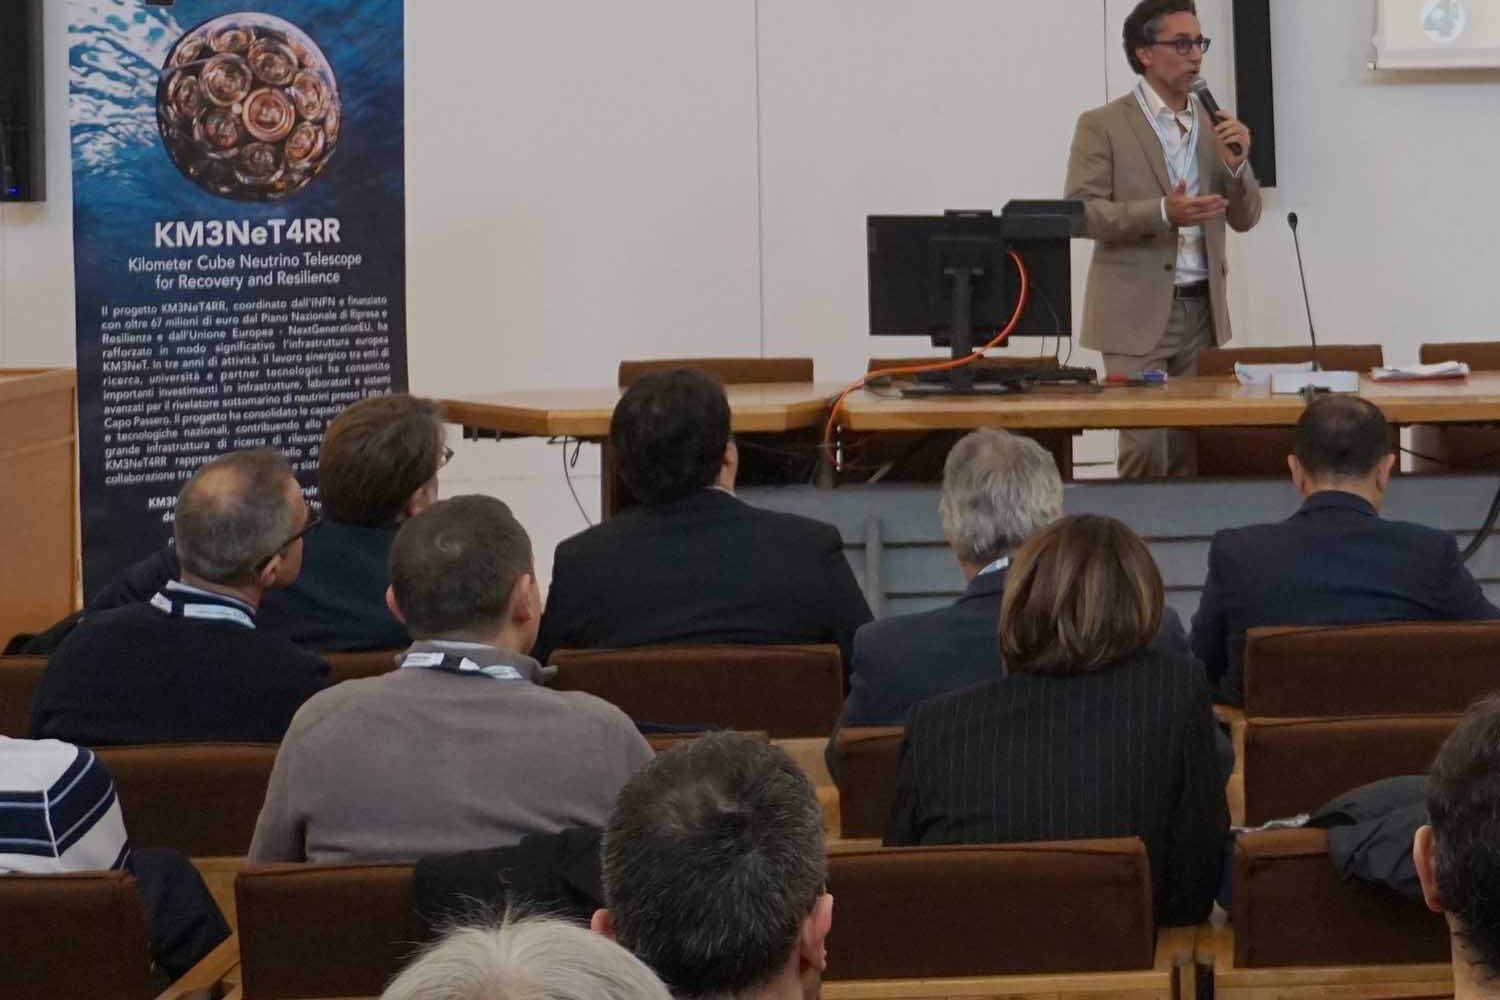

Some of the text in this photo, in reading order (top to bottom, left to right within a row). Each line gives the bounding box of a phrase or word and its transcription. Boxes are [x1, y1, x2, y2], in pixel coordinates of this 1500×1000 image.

[154, 217, 341, 248] KM3NeT4RR
[128, 250, 362, 273] Kilometer Cube Neutrino Telescope
[155, 269, 341, 292] for Recovery and Resilience
[113, 303, 158, 318] progetto
[233, 298, 287, 311] coordinato
[101, 320, 121, 330] con
[124, 317, 148, 329] oltre
[165, 315, 199, 328] milioni
[202, 314, 212, 326] di
[215, 315, 240, 326] euro
[242, 313, 258, 324] dal
[261, 312, 288, 323] Piano
[291, 310, 338, 322] Nazionale
[102, 332, 153, 345] Resilienza
[157, 333, 163, 342] e
[168, 329, 227, 341] dall'Unione
[232, 327, 274, 340] Europea
[102, 346, 153, 359] rafforzato
[159, 344, 169, 355] in
[176, 343, 207, 355] modo
[215, 340, 276, 355] significativo
[165, 359, 179, 369] tre
[182, 357, 205, 369] anni
[207, 356, 218, 367] di
[271, 351, 303, 363] lavoro
[305, 350, 347, 363] sinergico
[149, 371, 201, 384] università
[206, 371, 214, 380] e
[220, 369, 260, 382] partner
[266, 365, 323, 378] tecnologici
[328, 363, 340, 374] ha
[103, 388, 155, 402] importanti
[159, 383, 218, 397] investimenti
[223, 382, 233, 394] in
[307, 376, 351, 389] laboratori
[103, 403, 145, 415] avanzati
[146, 401, 162, 414] per
[172, 397, 220, 411] rivelatore
[222, 394, 281, 408] sottomarino
[283, 392, 292, 404] di
[294, 390, 330, 403] neutrini
[331, 389, 360, 404] presso
[103, 416, 132, 430] Capo
[182, 411, 227, 426] progetto
[229, 410, 241, 422] ha
[243, 407, 298, 420] consolidato
[104, 433, 112, 444] e
[117, 427, 179, 442] tecnologiche
[236, 419, 300, 434] contribuendo
[305, 417, 322, 429] allo
[105, 445, 141, 459] grande
[146, 440, 211, 454] infrastruttura
[217, 437, 227, 449] di
[233, 435, 266, 448] ricerca
[272, 434, 282, 446] di
[105, 455, 168, 471] KM3NeT4RR
[104, 470, 176, 486] collaborazione
